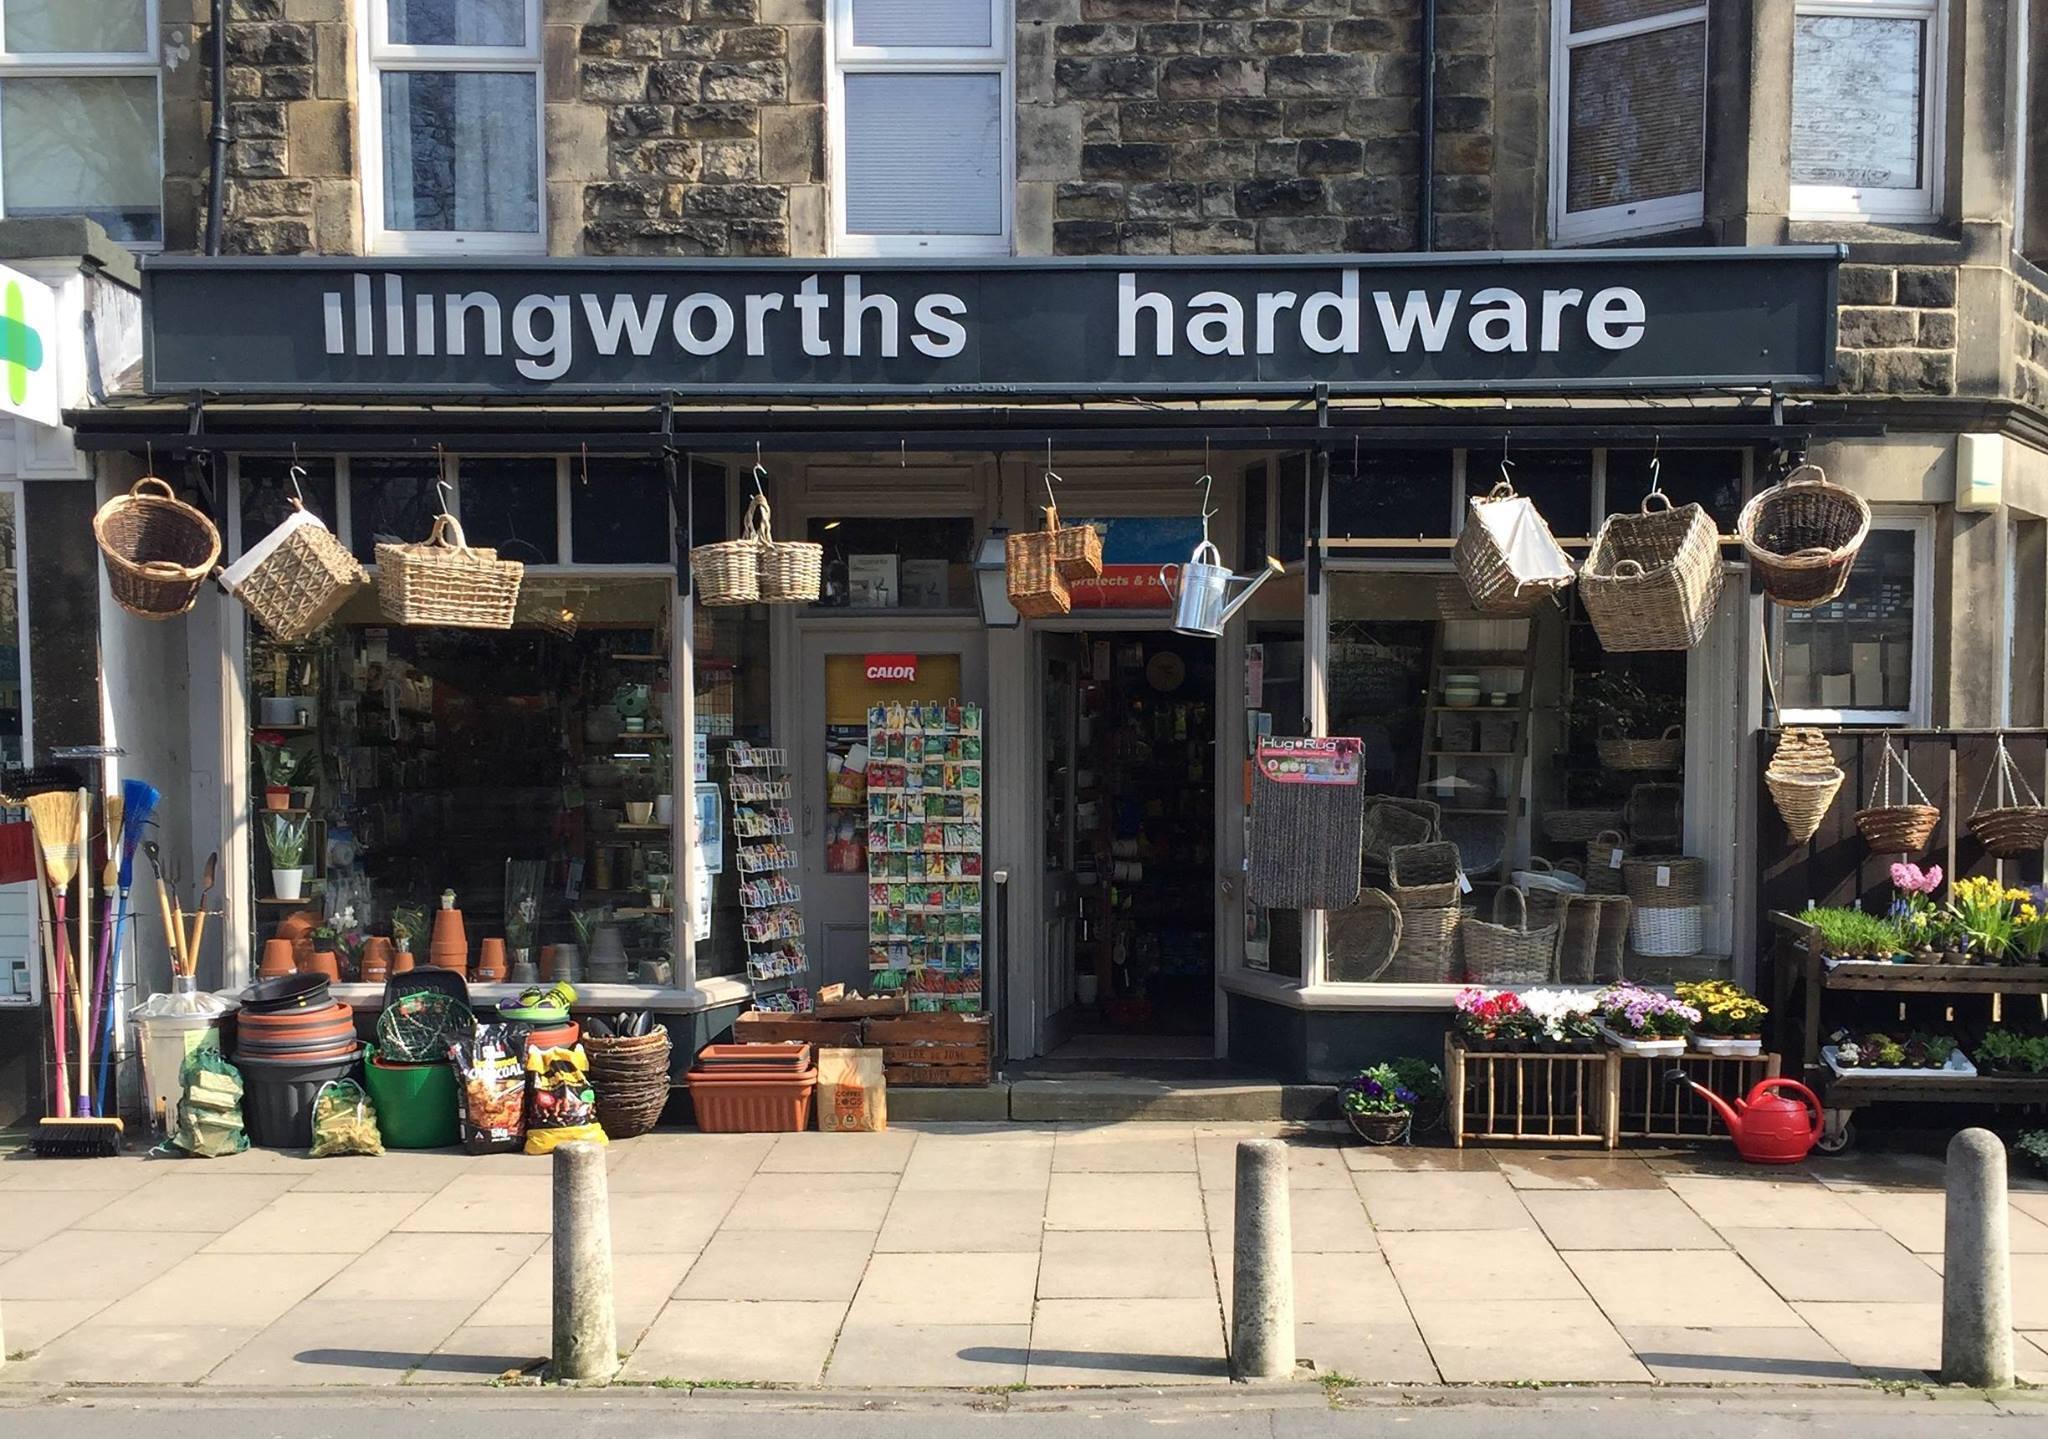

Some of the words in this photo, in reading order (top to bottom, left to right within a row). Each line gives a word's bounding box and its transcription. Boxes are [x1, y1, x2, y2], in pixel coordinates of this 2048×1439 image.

[324, 273, 967, 381] illingworths
[1118, 269, 1646, 356] hardware
[1071, 575, 1129, 588] protects
[1134, 575, 1143, 586] &
[867, 666, 915, 681] CALOR
[1262, 738, 1295, 751] Hug
[1304, 738, 1337, 752] Rug
